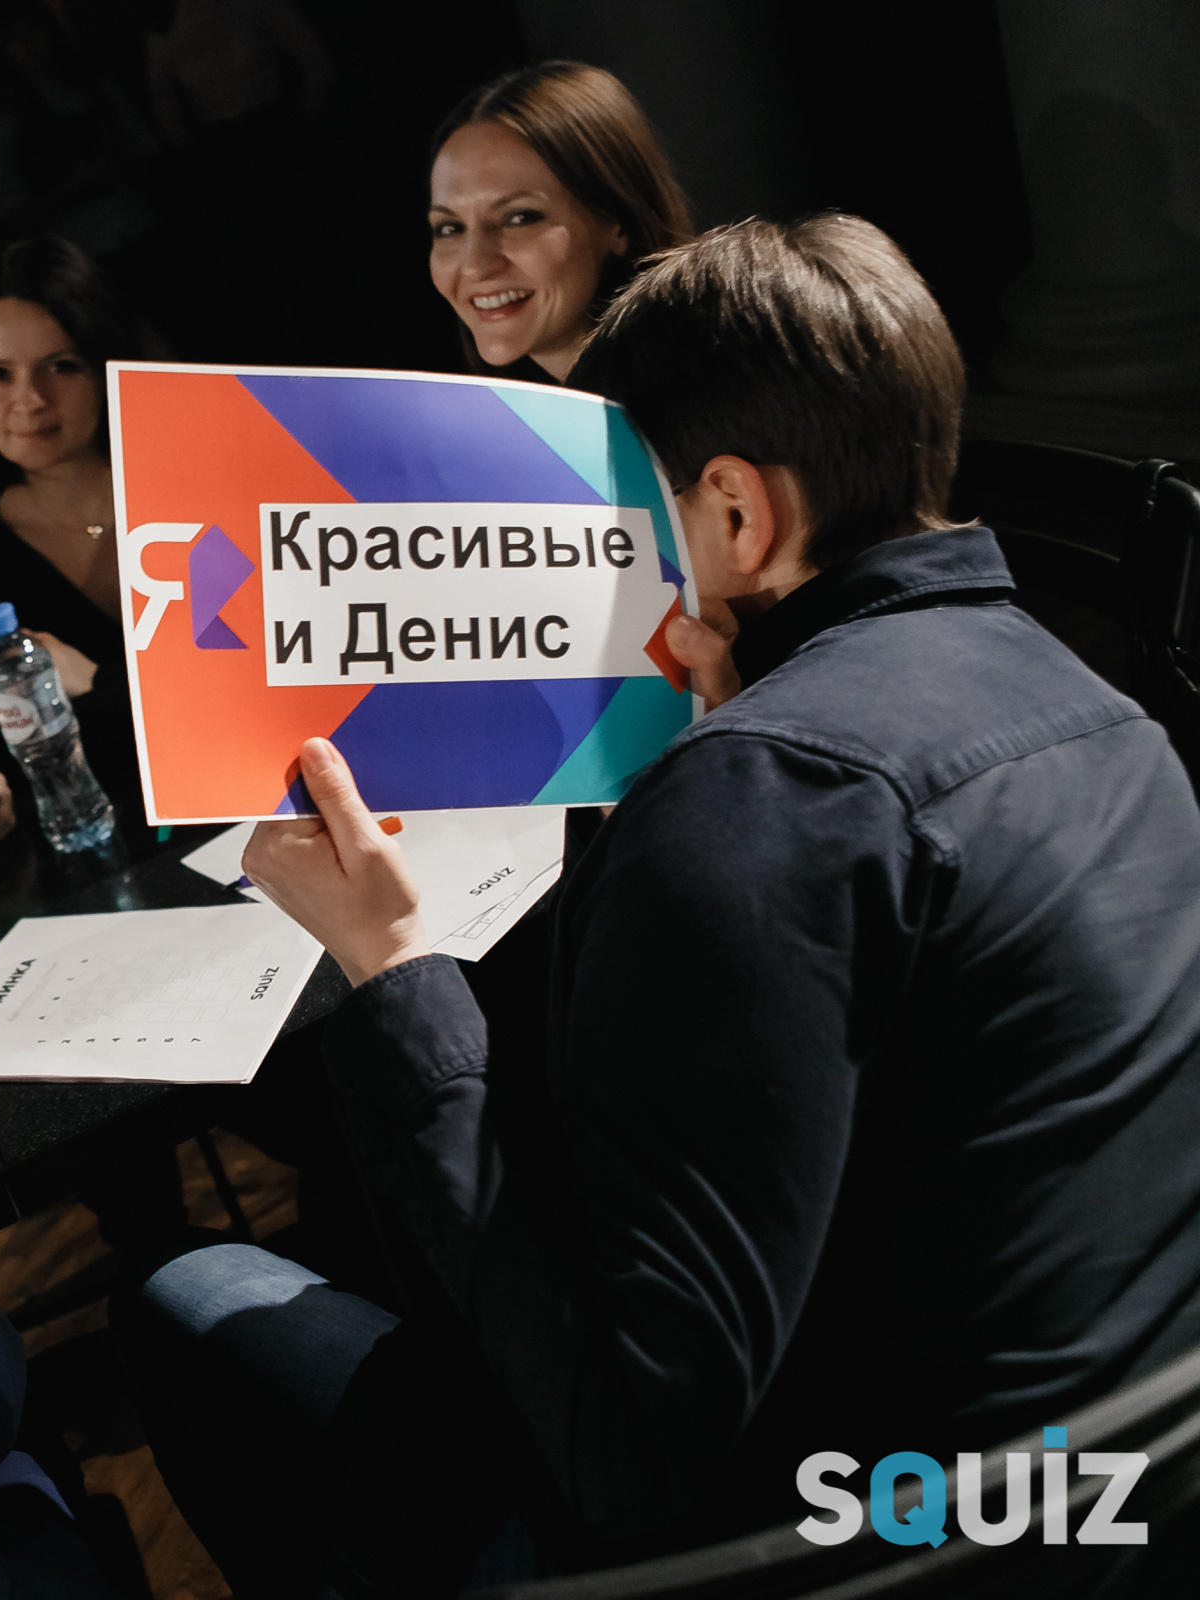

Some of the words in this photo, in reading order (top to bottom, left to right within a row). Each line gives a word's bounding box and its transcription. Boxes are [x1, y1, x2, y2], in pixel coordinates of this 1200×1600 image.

[269, 511, 636, 588] Красивые
[274, 619, 313, 665] и
[340, 602, 571, 676] Денис
